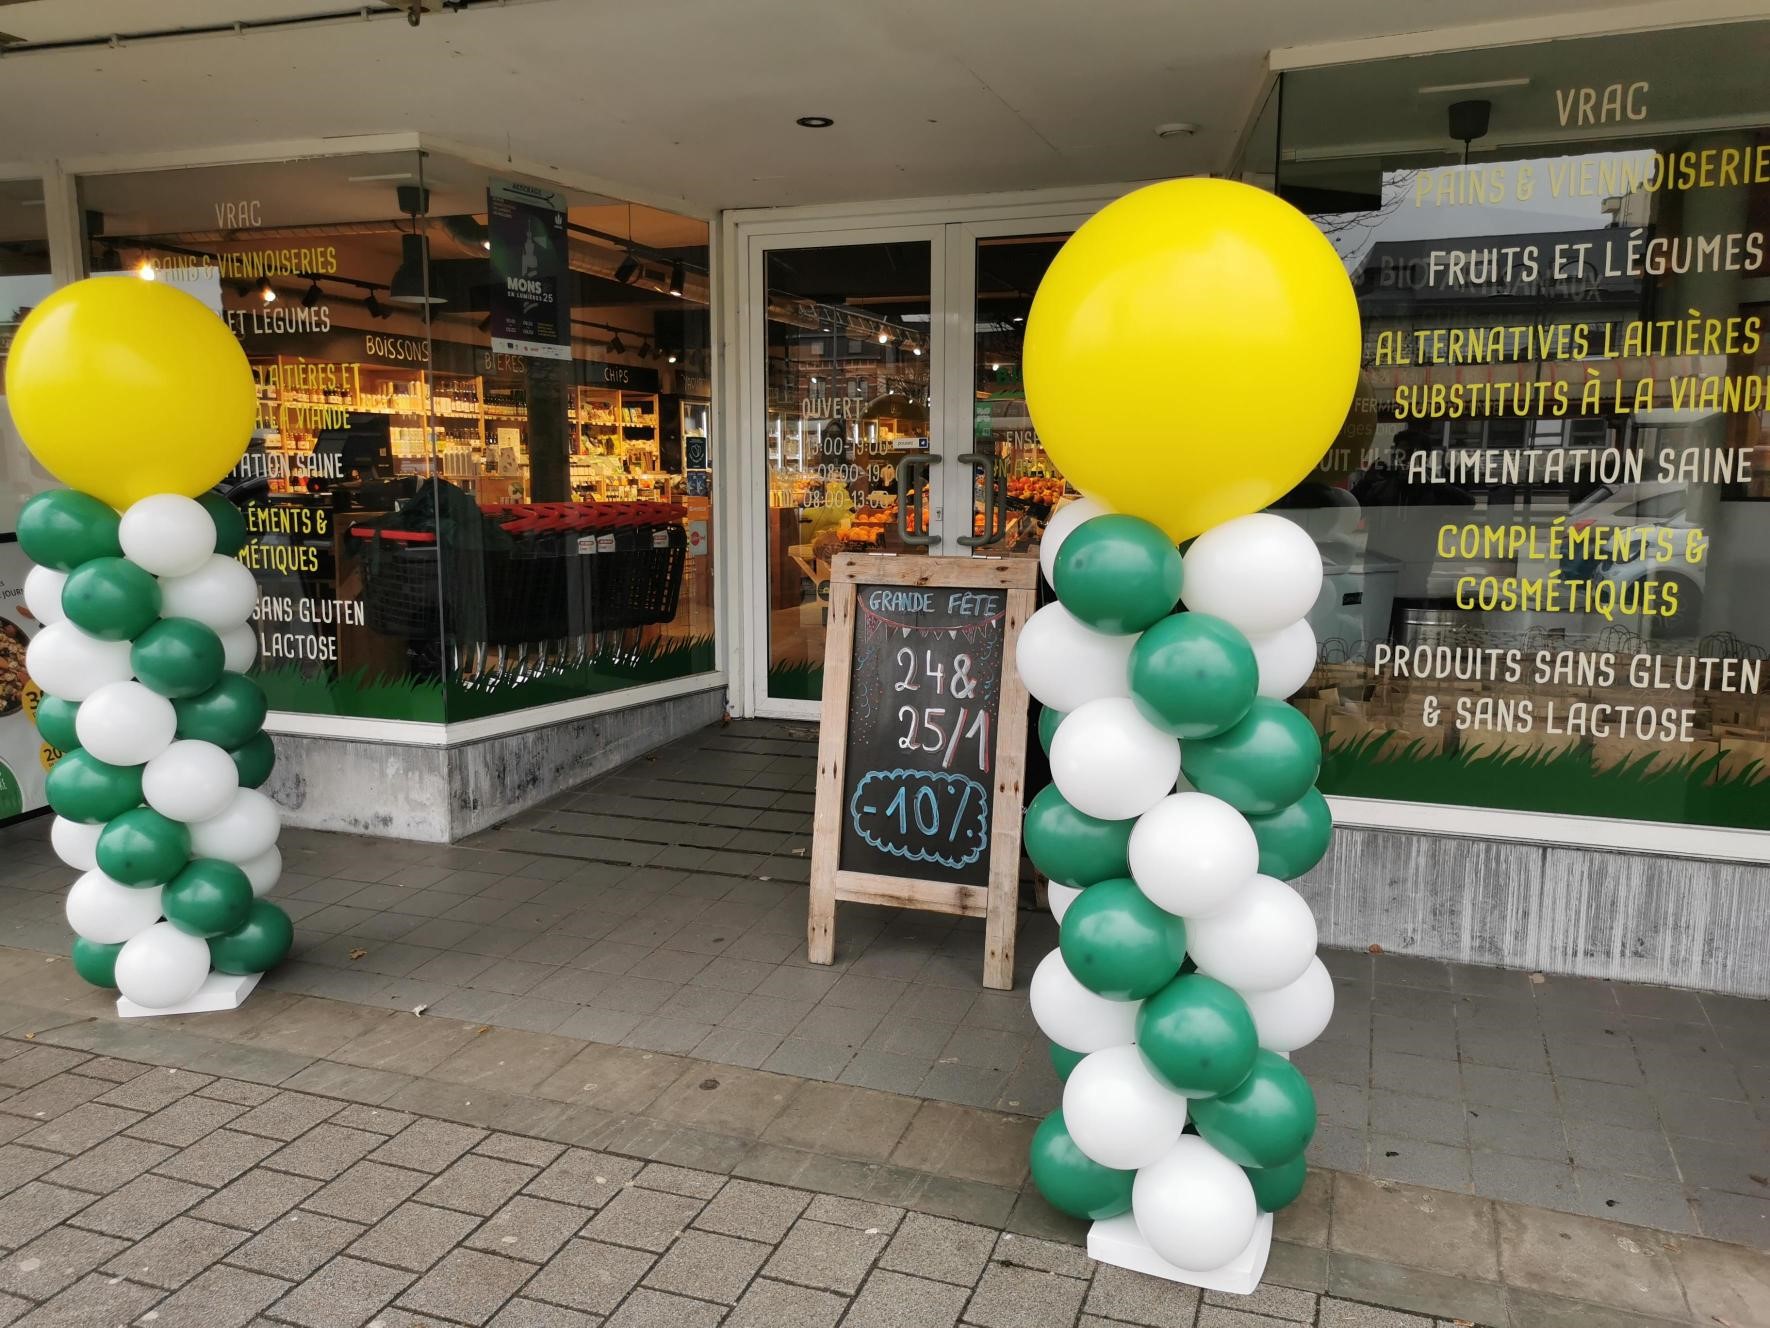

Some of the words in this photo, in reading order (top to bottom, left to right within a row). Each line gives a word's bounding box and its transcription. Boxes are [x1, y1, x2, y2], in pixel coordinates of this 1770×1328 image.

[1556, 81, 1649, 127] VRAC
[1415, 167, 1505, 208] PAINS
[1515, 166, 1535, 202] &
[214, 200, 263, 230] VRAC
[216, 246, 338, 279] VIENNOISERIES
[1429, 246, 1539, 287] FRUITS
[1553, 243, 1593, 280] ET
[1604, 228, 1764, 278] LÉGUMES
[507, 276, 542, 295] MONS
[542, 292, 554, 303] 25
[227, 309, 248, 336] ET
[252, 301, 331, 335] LÉGUMES
[1375, 322, 1589, 367] ALTERNATIVES
[1603, 308, 1762, 358] LAITIÈRES
[341, 362, 361, 390] ET
[1394, 381, 1568, 420] SUBSTITUTS
[1580, 367, 1601, 416] À
[1614, 377, 1654, 415] LA
[1669, 375, 1770, 414] VIAND
[295, 402, 352, 431] VIANDE
[296, 452, 344, 479] SAINE
[1407, 447, 1644, 485] ALIMENTATION
[1657, 446, 1754, 485] SAINE
[247, 501, 312, 534] ÉMENTS
[316, 509, 328, 535] &
[236, 538, 319, 576] MÉTIQUES
[1437, 516, 1675, 564] COMPLÉMENTS
[1685, 528, 1707, 564] &
[252, 596, 293, 622] SANS
[299, 597, 365, 627] GLUTEN
[869, 589, 936, 614] GRANDE
[947, 590, 1000, 617] FÊTE
[1455, 569, 1679, 622] COSMÉTIQUES
[261, 632, 338, 661] LACTOSE
[1373, 643, 1522, 683] PRODUITS
[1534, 650, 1616, 688] SANS
[1629, 653, 1761, 695] GLUTEN
[1422, 694, 1441, 728] &
[1455, 697, 1533, 734] SANS
[1546, 701, 1697, 743] LACTOSE
